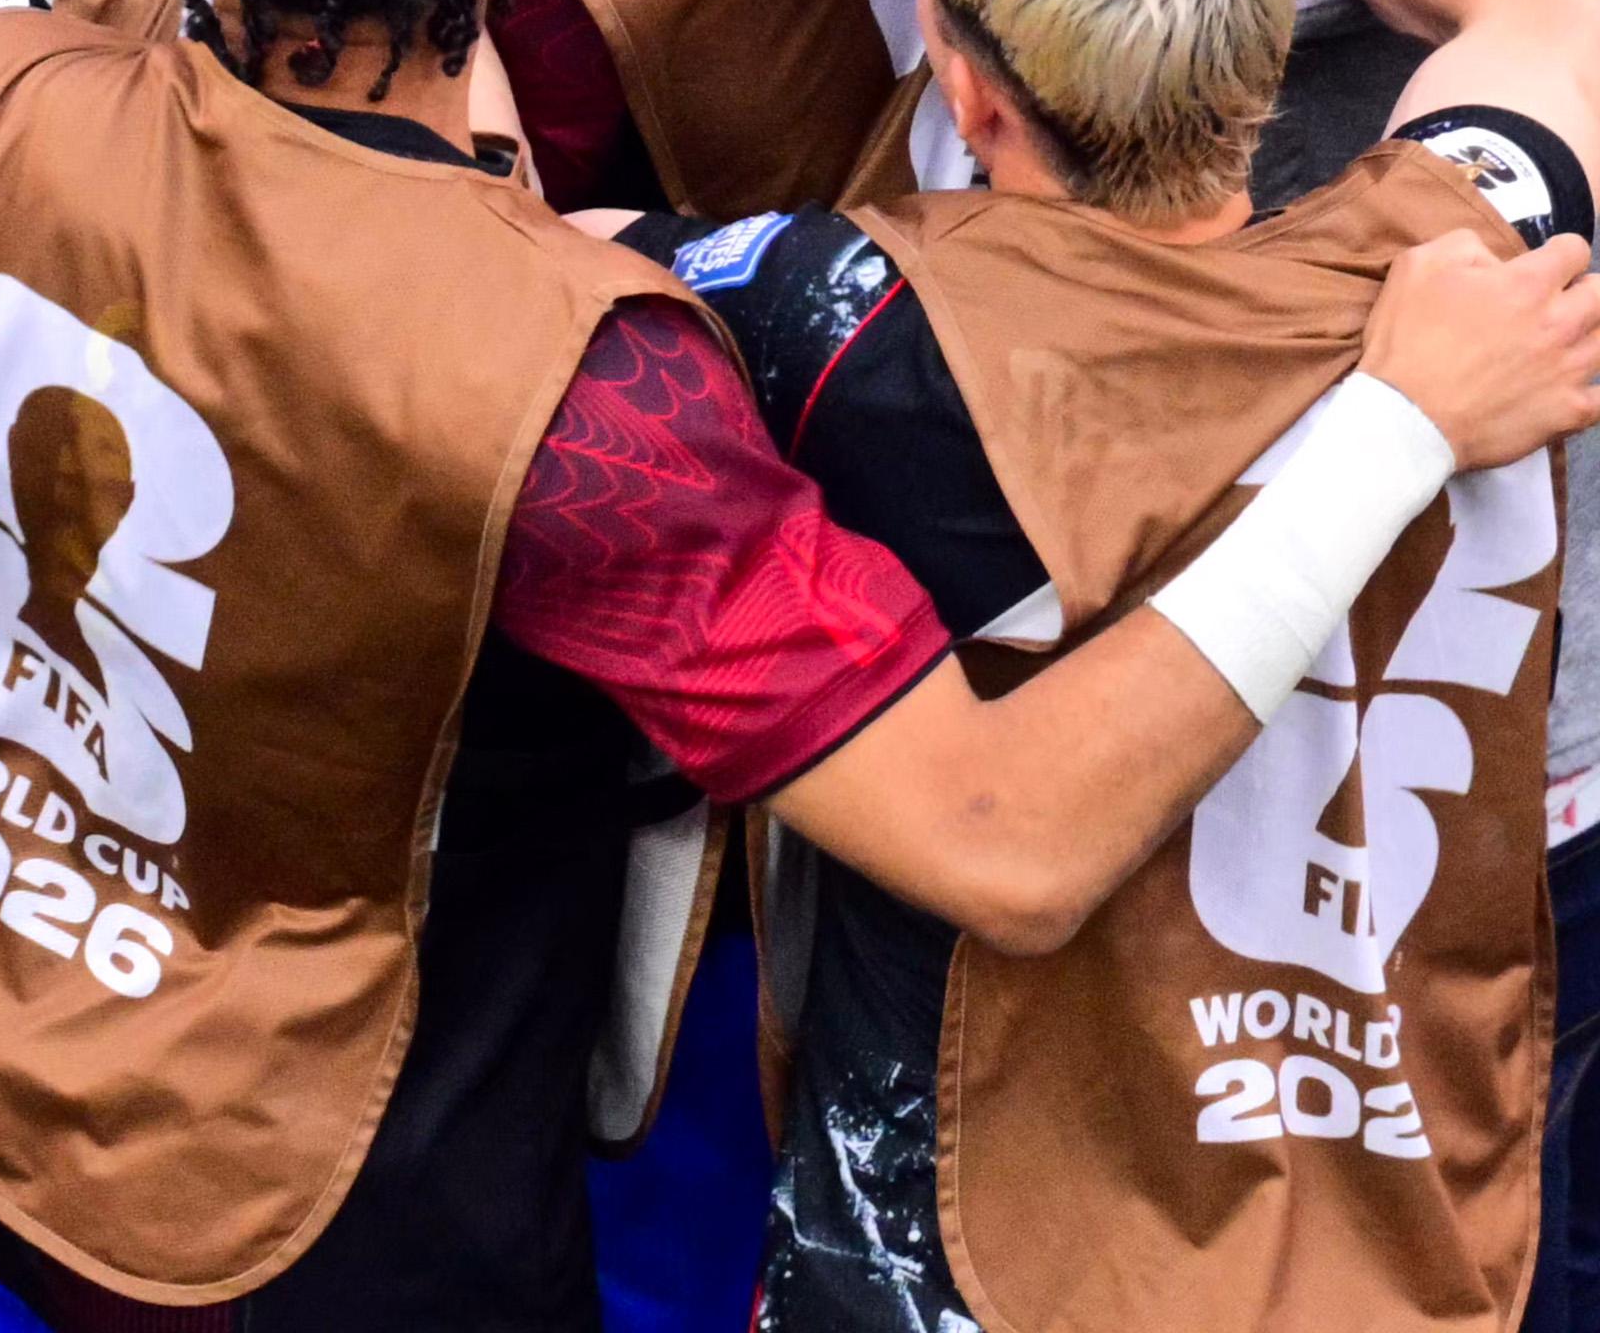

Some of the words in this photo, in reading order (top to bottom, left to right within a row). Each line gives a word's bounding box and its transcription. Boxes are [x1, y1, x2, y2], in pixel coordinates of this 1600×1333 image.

[3, 639, 111, 785] FIFA
[83, 834, 191, 911] CUP
[1189, 989, 1401, 1070] WORLD
